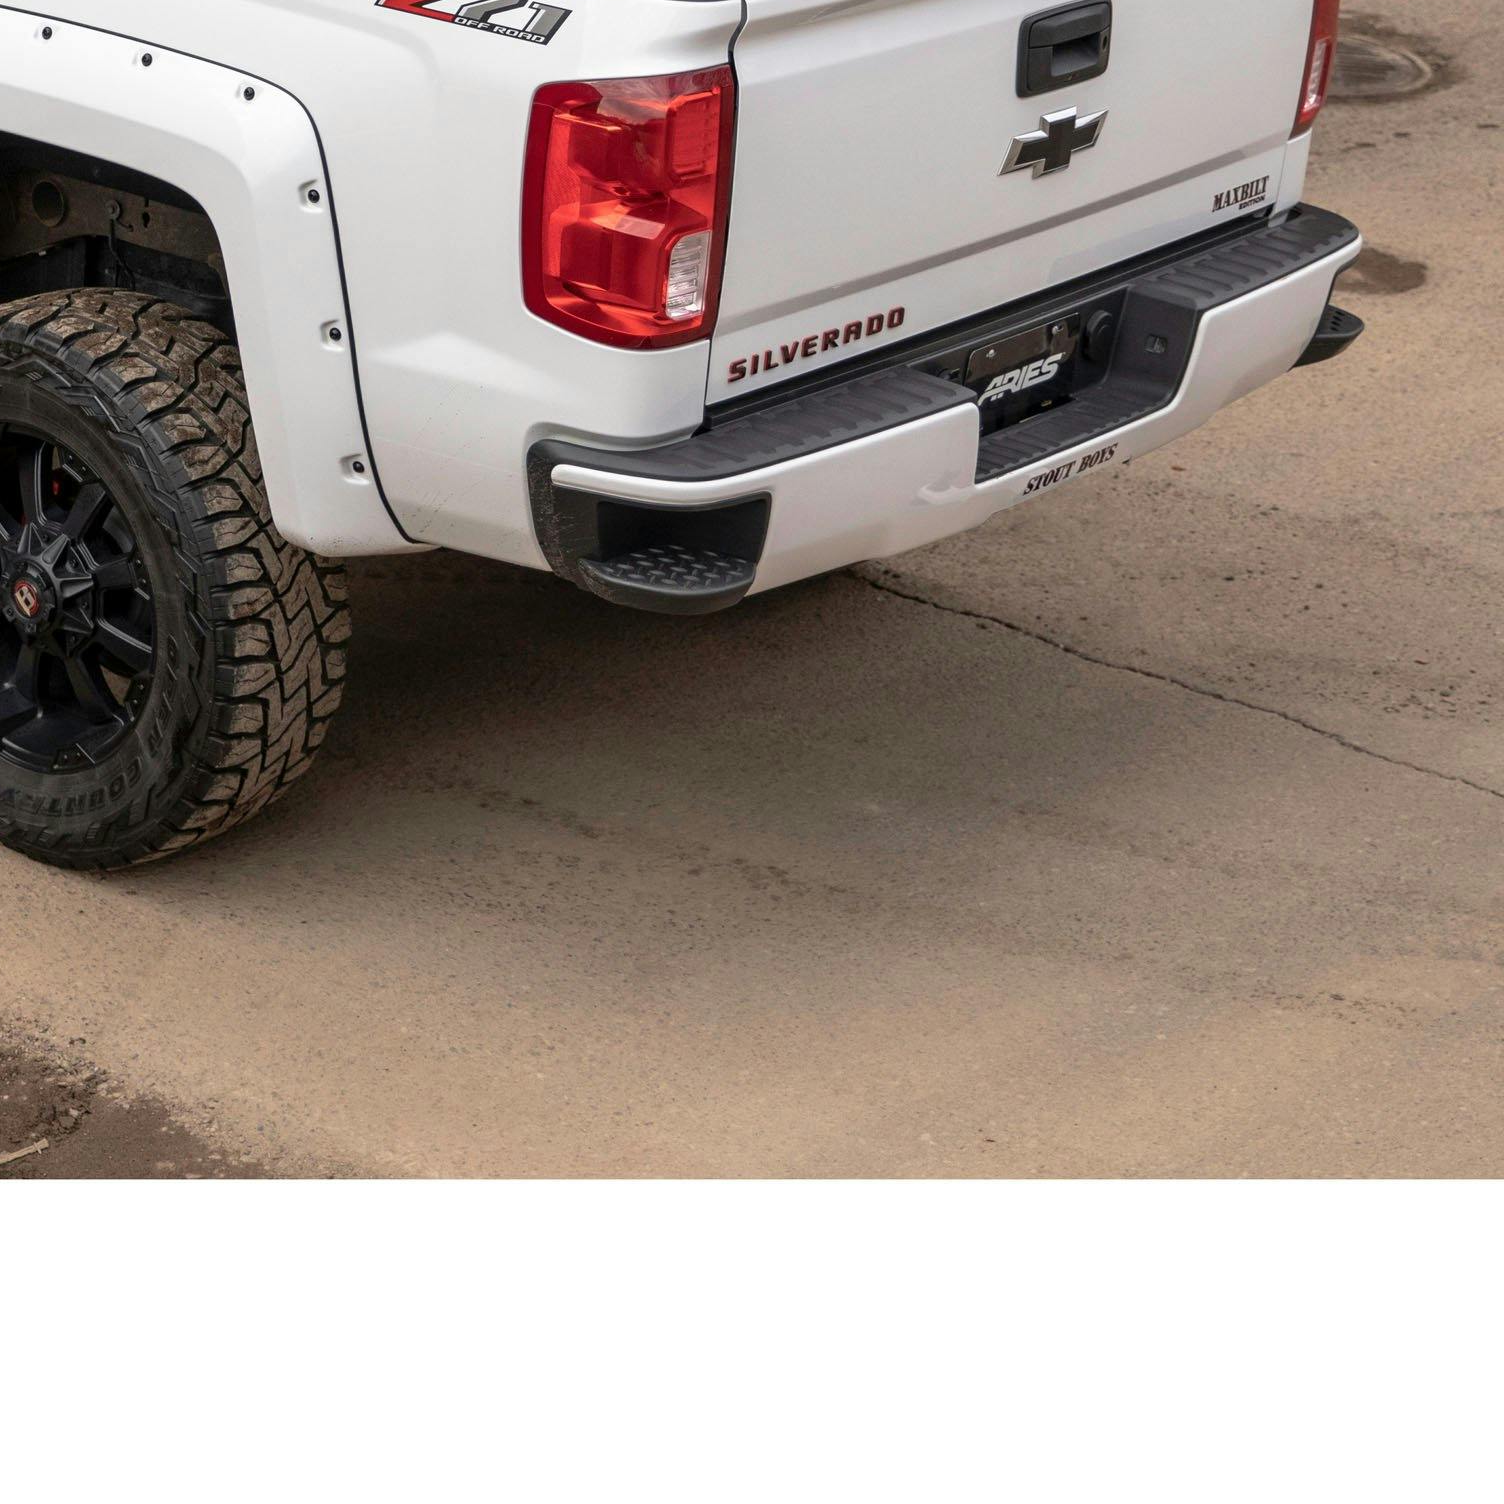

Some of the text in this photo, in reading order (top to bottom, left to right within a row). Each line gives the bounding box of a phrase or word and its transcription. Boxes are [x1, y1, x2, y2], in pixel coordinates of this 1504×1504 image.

[453, 16, 546, 44] OFF ROAD
[1212, 175, 1269, 212] MAXBILT
[1238, 194, 1266, 210] EDITION
[727, 306, 906, 383] SILVERADO
[977, 352, 1064, 406] ARIES
[1023, 443, 1118, 495] STOUT BOYS
